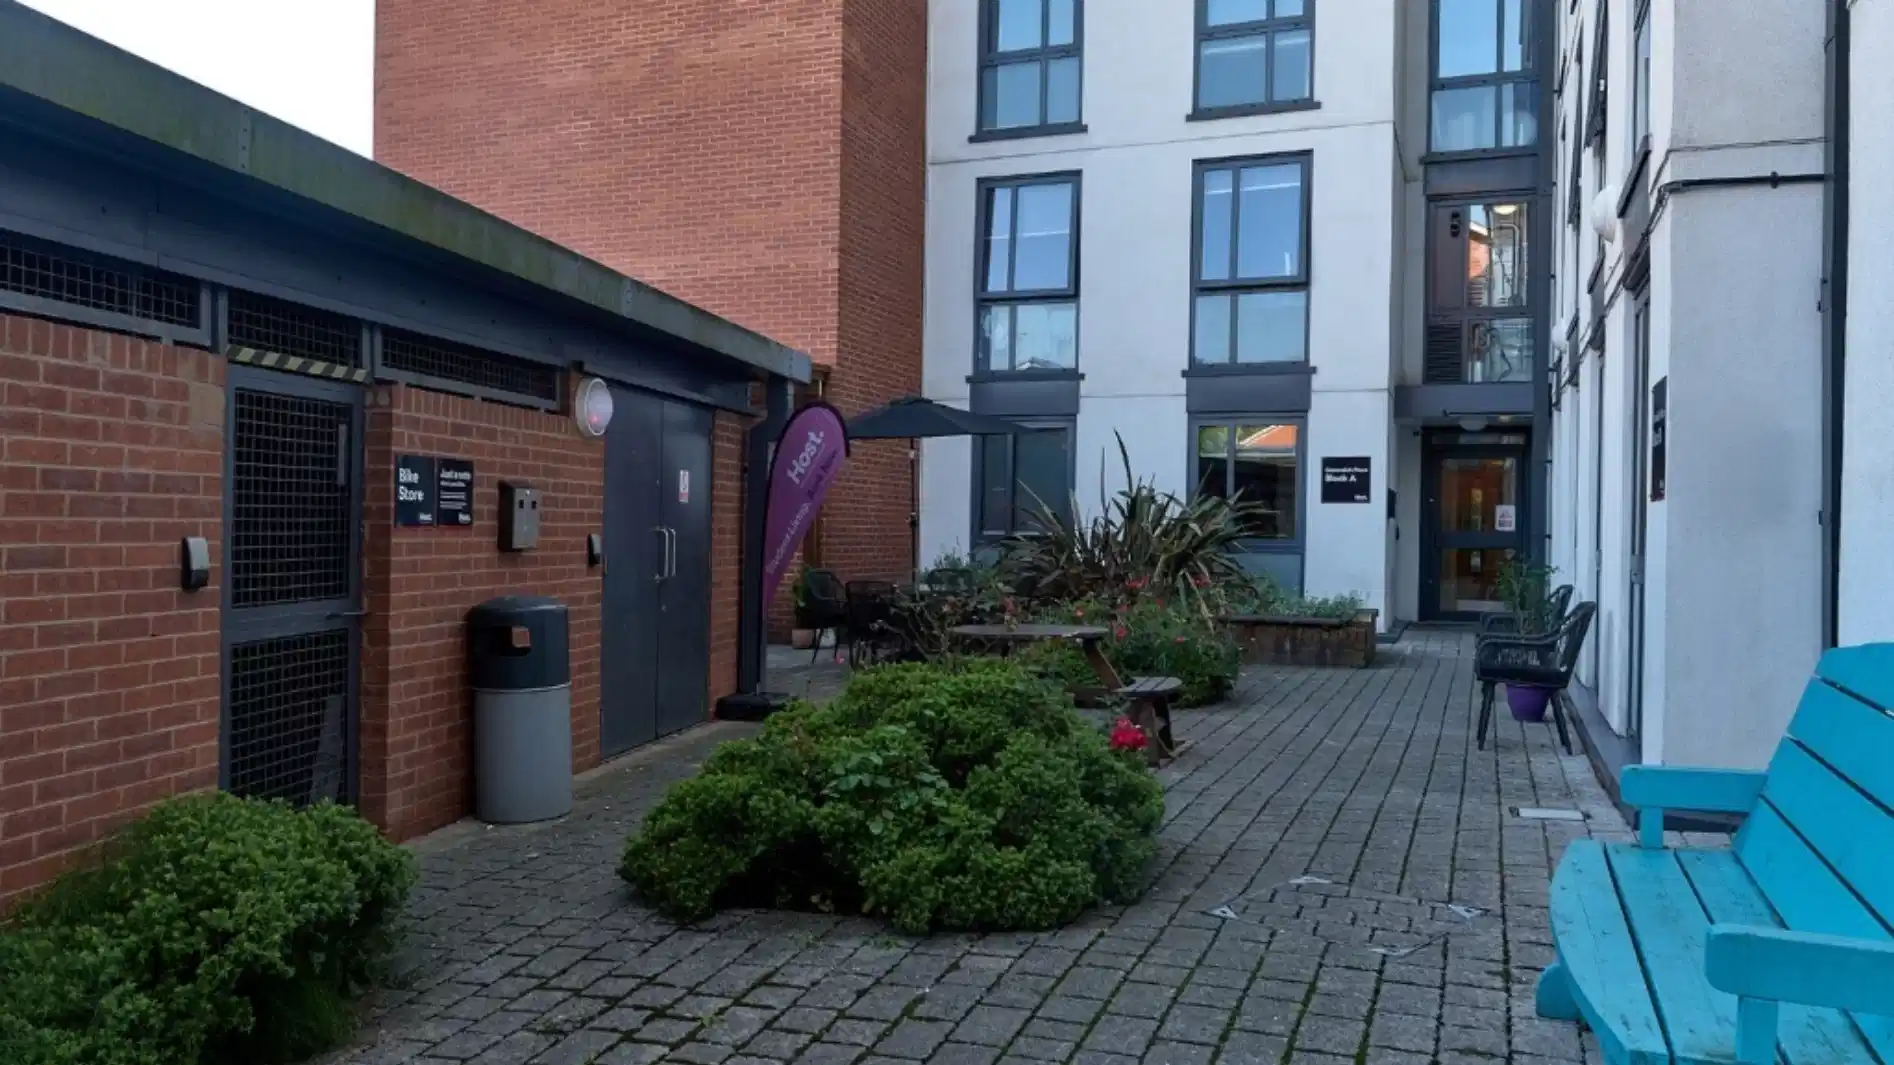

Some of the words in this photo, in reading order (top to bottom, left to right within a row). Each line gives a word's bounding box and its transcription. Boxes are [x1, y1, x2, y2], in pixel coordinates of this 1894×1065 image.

[786, 430, 825, 485] Host.
[399, 467, 419, 484] Bike
[399, 485, 424, 502] Store
